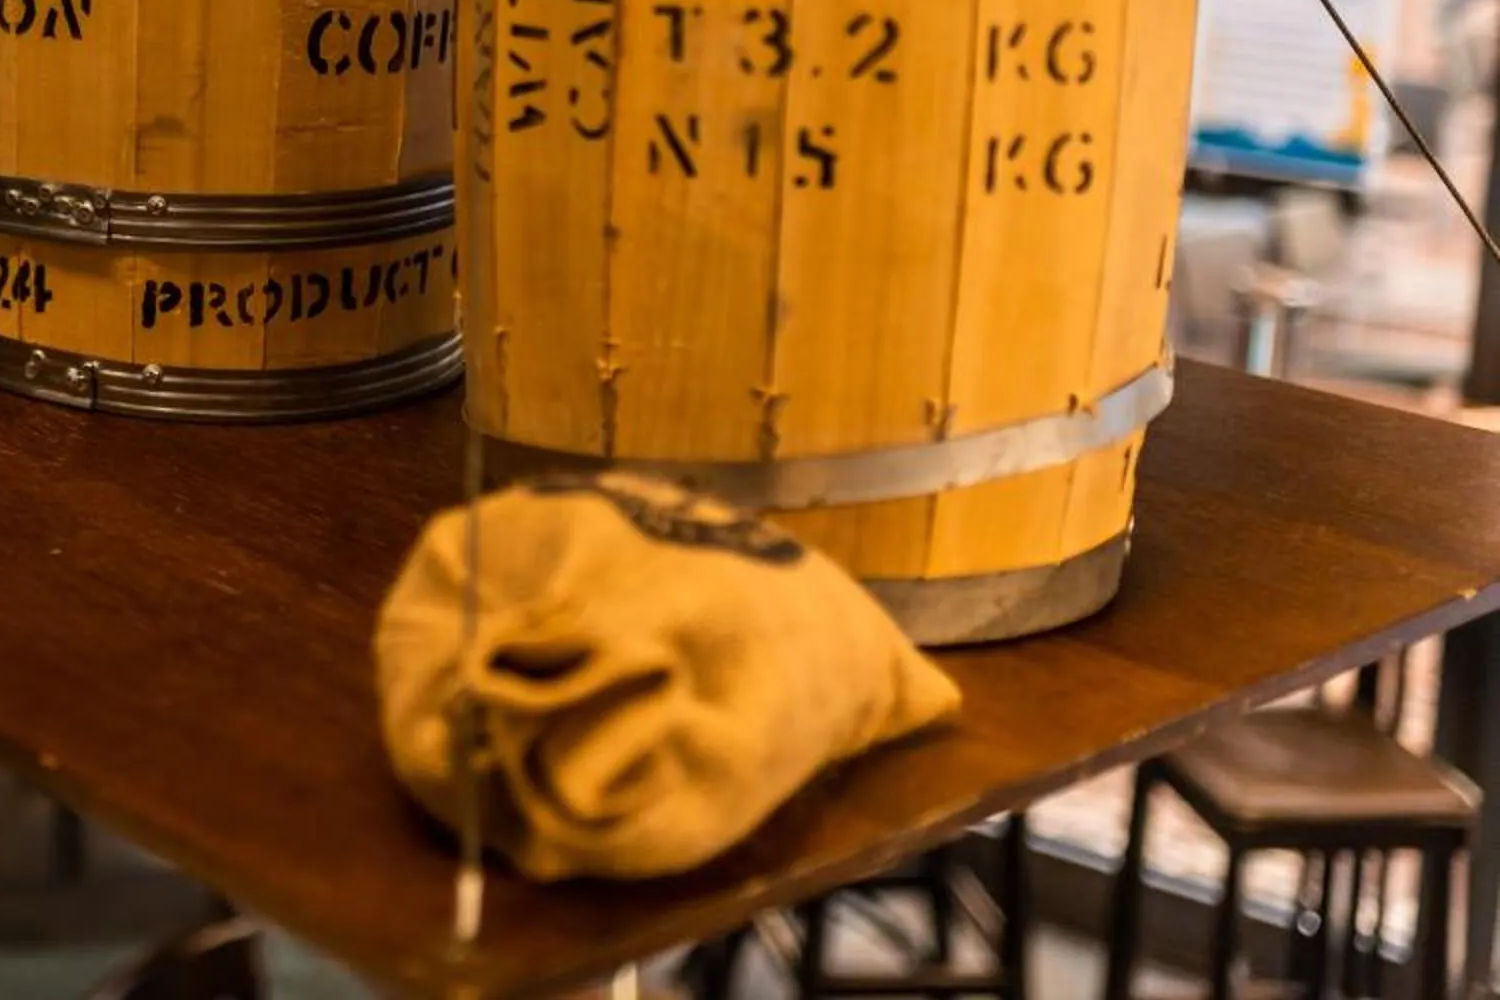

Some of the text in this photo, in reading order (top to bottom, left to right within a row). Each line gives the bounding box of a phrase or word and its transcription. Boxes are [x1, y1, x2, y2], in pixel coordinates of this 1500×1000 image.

[653, 4, 1097, 85] T 3.2 KG
[647, 114, 1094, 195] N 15 KG
[141, 244, 444, 328] PRODUCT
